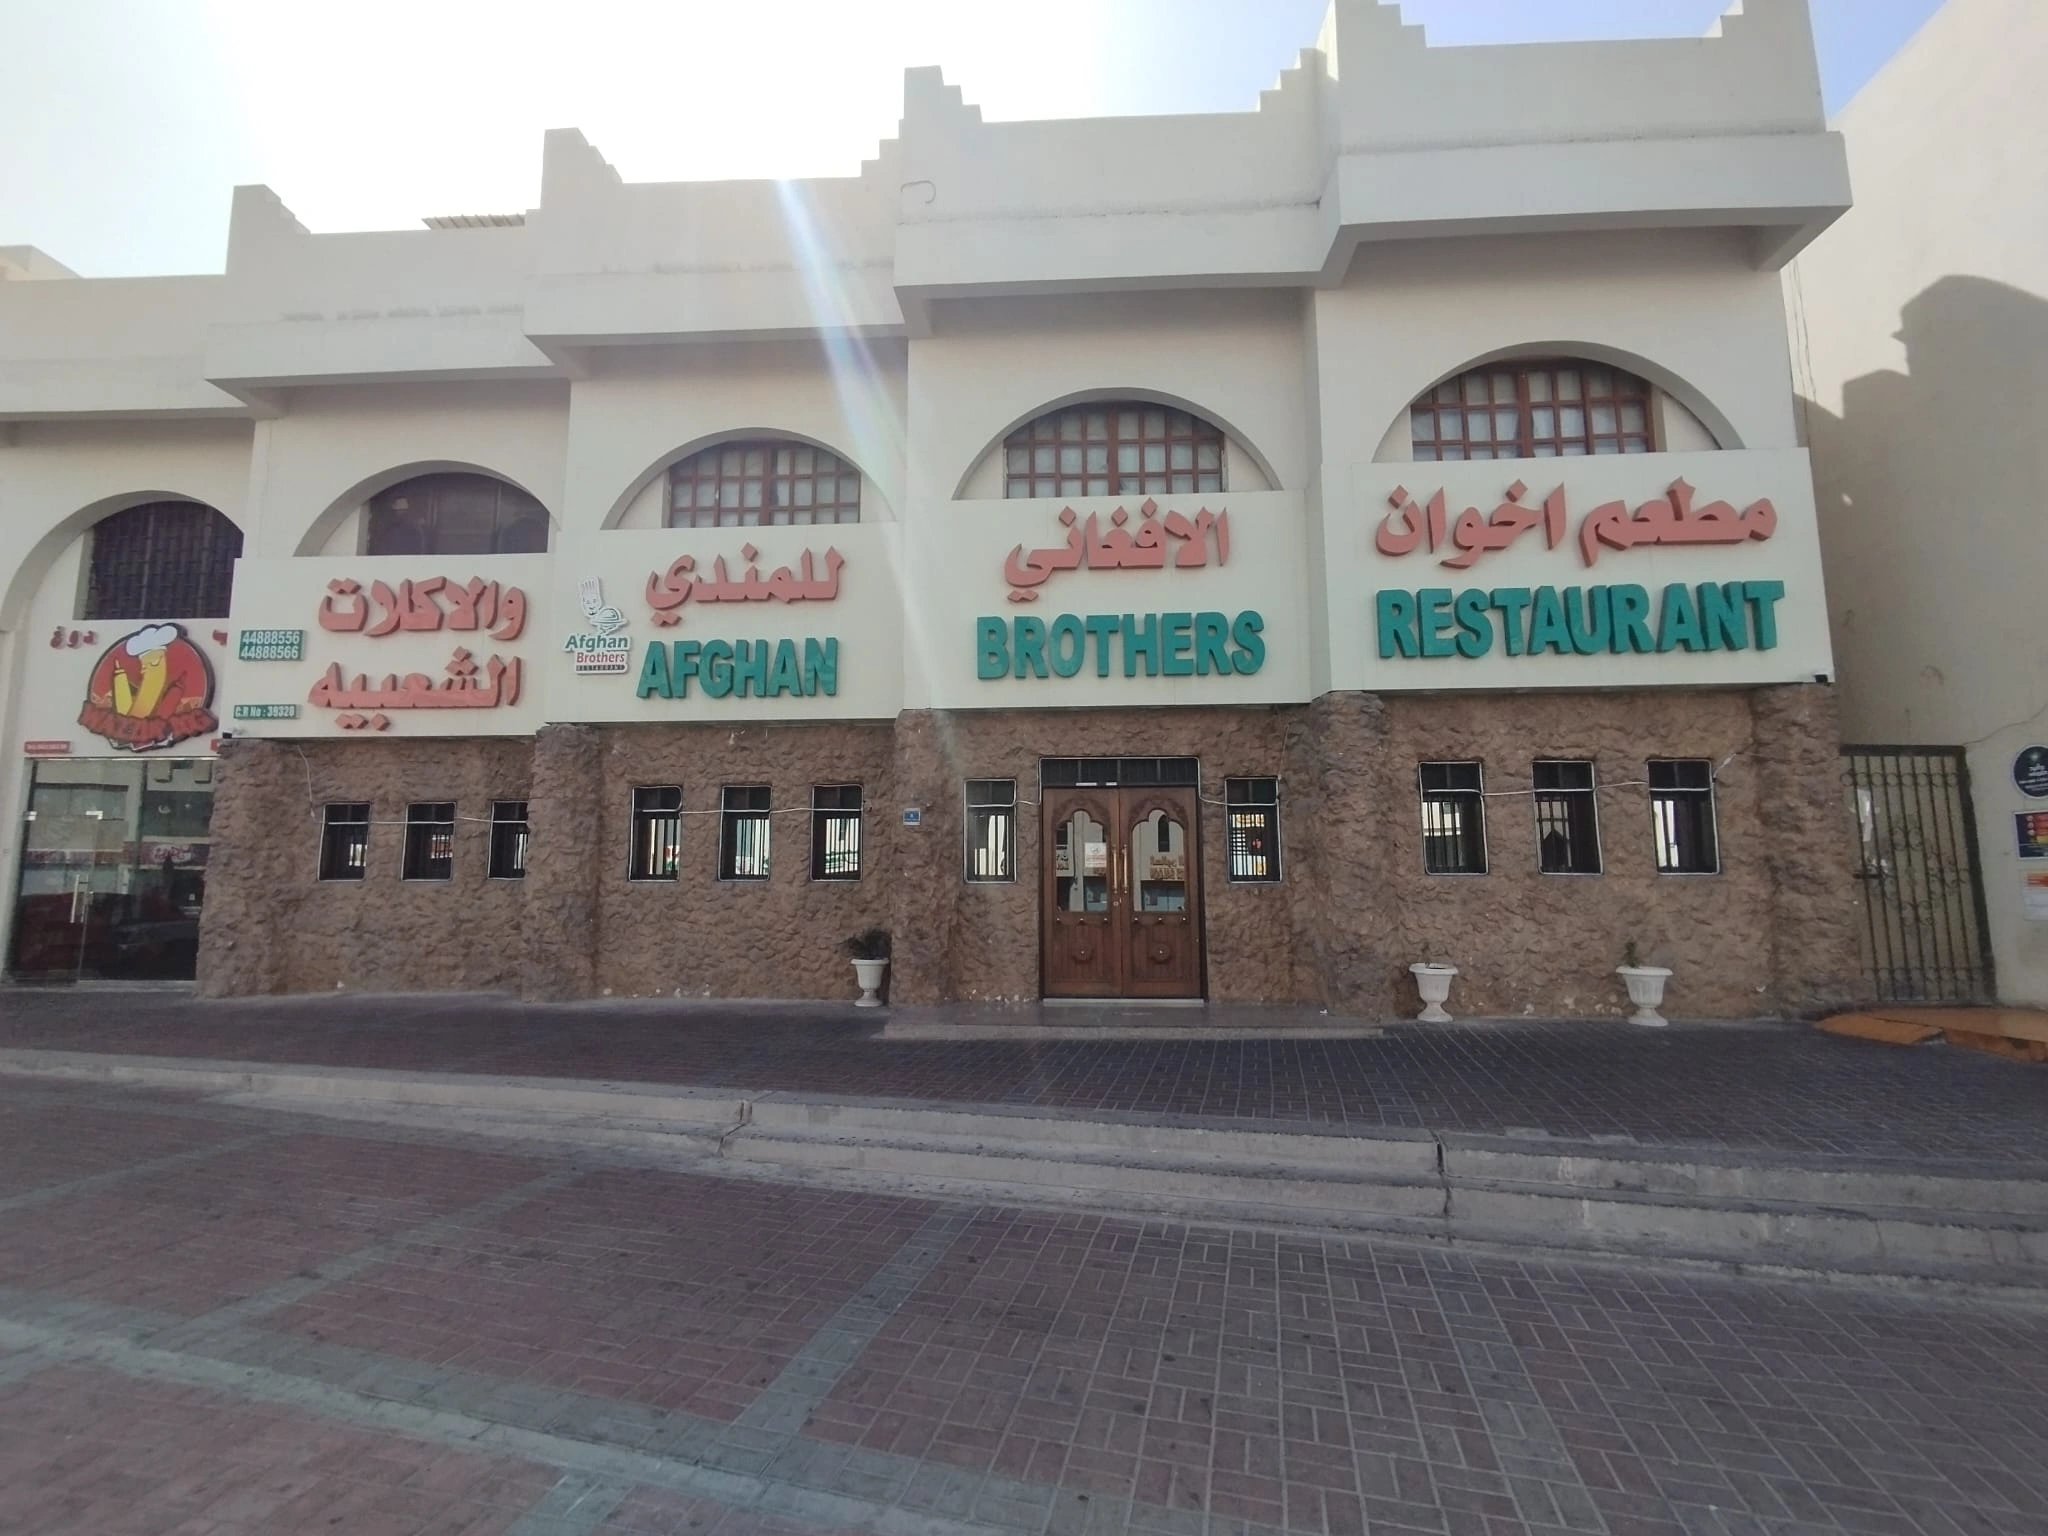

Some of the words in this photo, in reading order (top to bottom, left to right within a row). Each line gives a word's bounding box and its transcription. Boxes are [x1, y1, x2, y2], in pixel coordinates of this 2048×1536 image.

[1004, 497, 1230, 602] الافغاني
[1375, 479, 1567, 569] اخوان
[1579, 476, 1778, 568] مطعم
[318, 576, 527, 641] والاكلات
[646, 542, 845, 627] للمندي
[241, 645, 299, 658] 44888566
[242, 631, 300, 644] 44888556
[565, 635, 628, 652] Afghan
[977, 610, 1266, 680] BROTHERS
[1376, 581, 1785, 658] RESTAURANT
[576, 652, 625, 663] Brothers
[636, 637, 839, 699] AFGHAN
